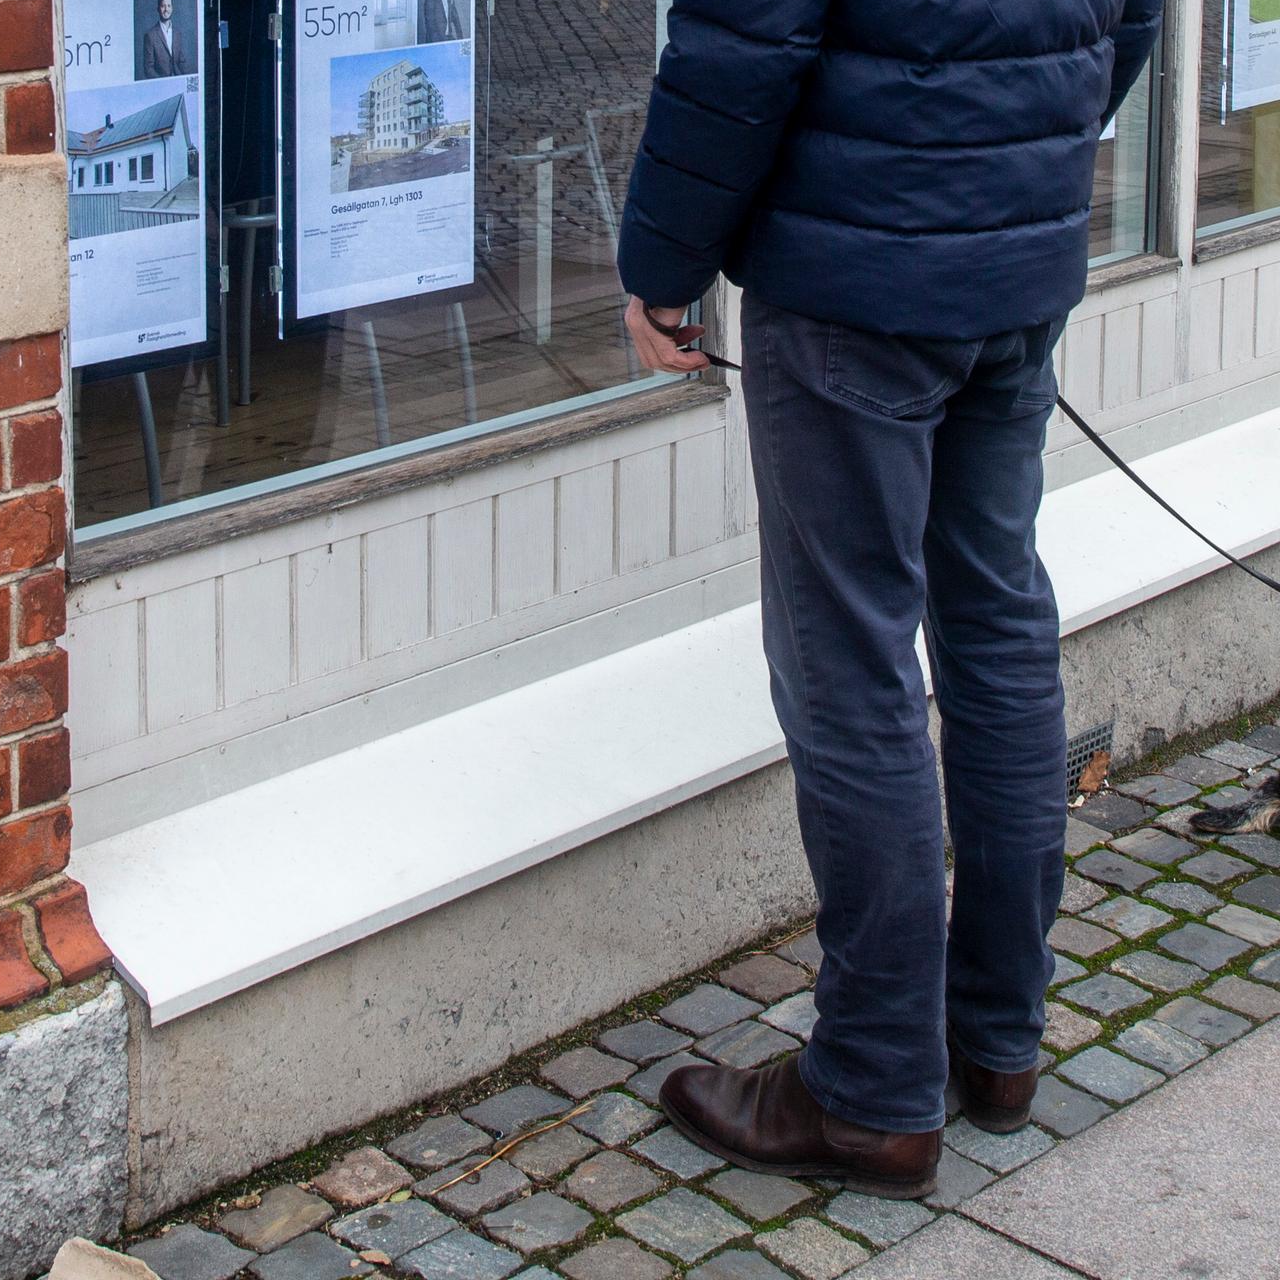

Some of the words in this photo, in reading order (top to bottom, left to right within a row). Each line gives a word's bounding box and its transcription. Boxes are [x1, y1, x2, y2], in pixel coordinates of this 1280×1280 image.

[304, 4, 368, 38] 55m²
[331, 199, 380, 215] Gesällgatan
[389, 194, 404, 207] Lgh
[405, 190, 423, 202] 1303
[84, 249, 95, 260] 12
